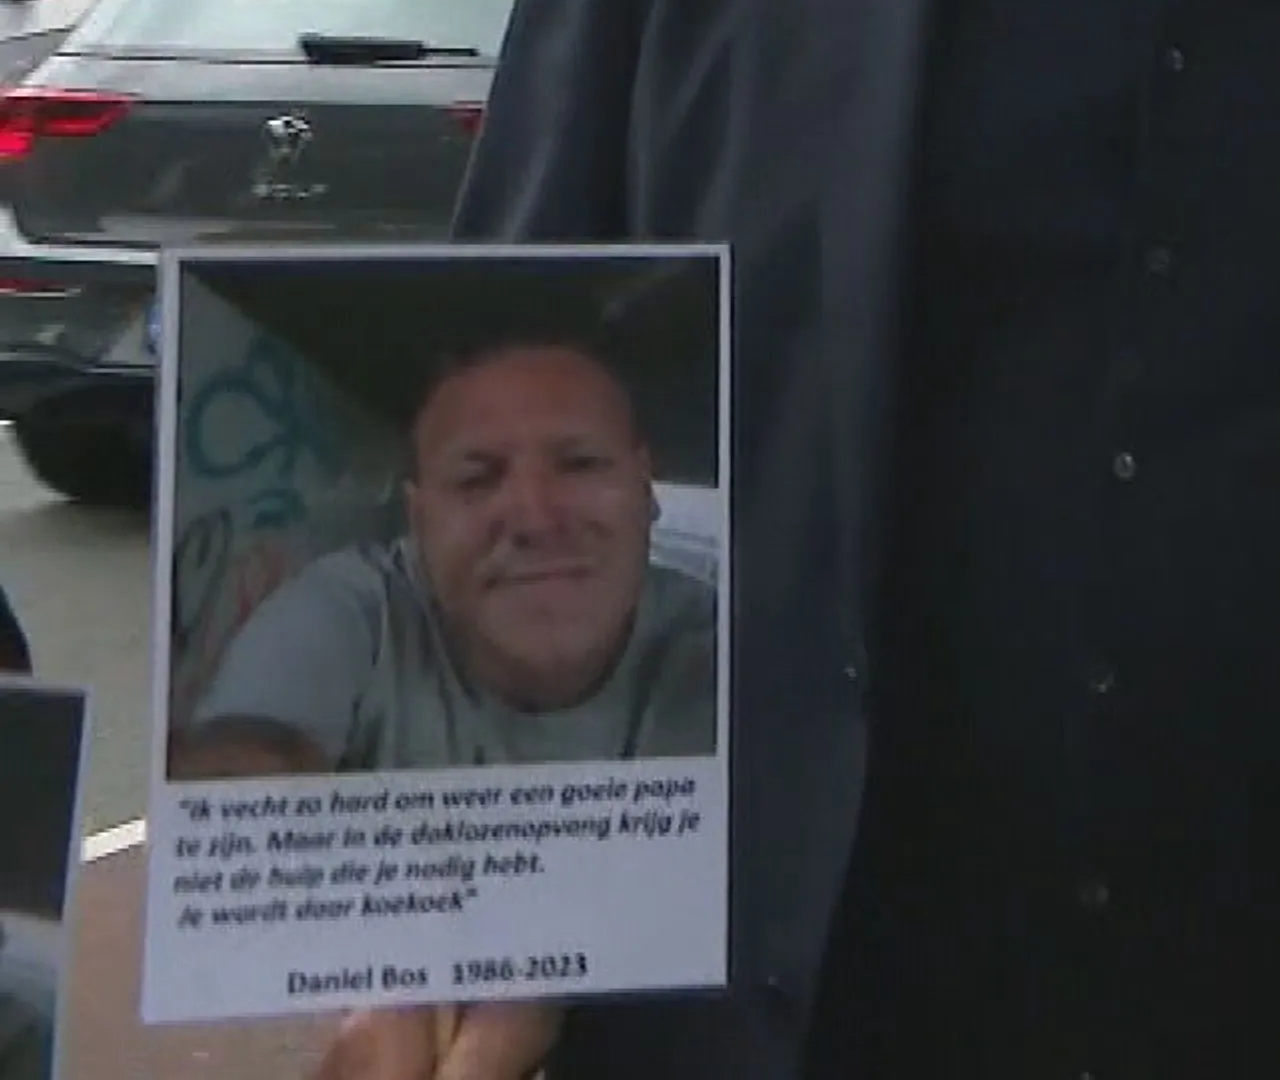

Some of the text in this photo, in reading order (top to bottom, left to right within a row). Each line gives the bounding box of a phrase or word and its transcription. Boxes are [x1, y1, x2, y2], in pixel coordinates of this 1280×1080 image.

[221, 795, 288, 819] vecht
[296, 796, 322, 816] zo
[331, 788, 390, 813] hard
[395, 791, 434, 809] om
[442, 788, 501, 807] weer
[510, 785, 554, 805] een
[560, 777, 628, 806] goeie
[633, 777, 695, 804] papa
[176, 836, 199, 857] te
[267, 830, 335, 853] Maar
[343, 827, 365, 847] in
[374, 824, 402, 847] de
[411, 817, 610, 846] daklozenopvang
[618, 809, 672, 841] krijg
[678, 808, 701, 836] je
[173, 849, 544, 893] niet de hulp die je nodig hebt.
[211, 898, 288, 925] wordt
[295, 897, 354, 920] daar
[288, 951, 588, 994] Daniel Bos 1986-2023
